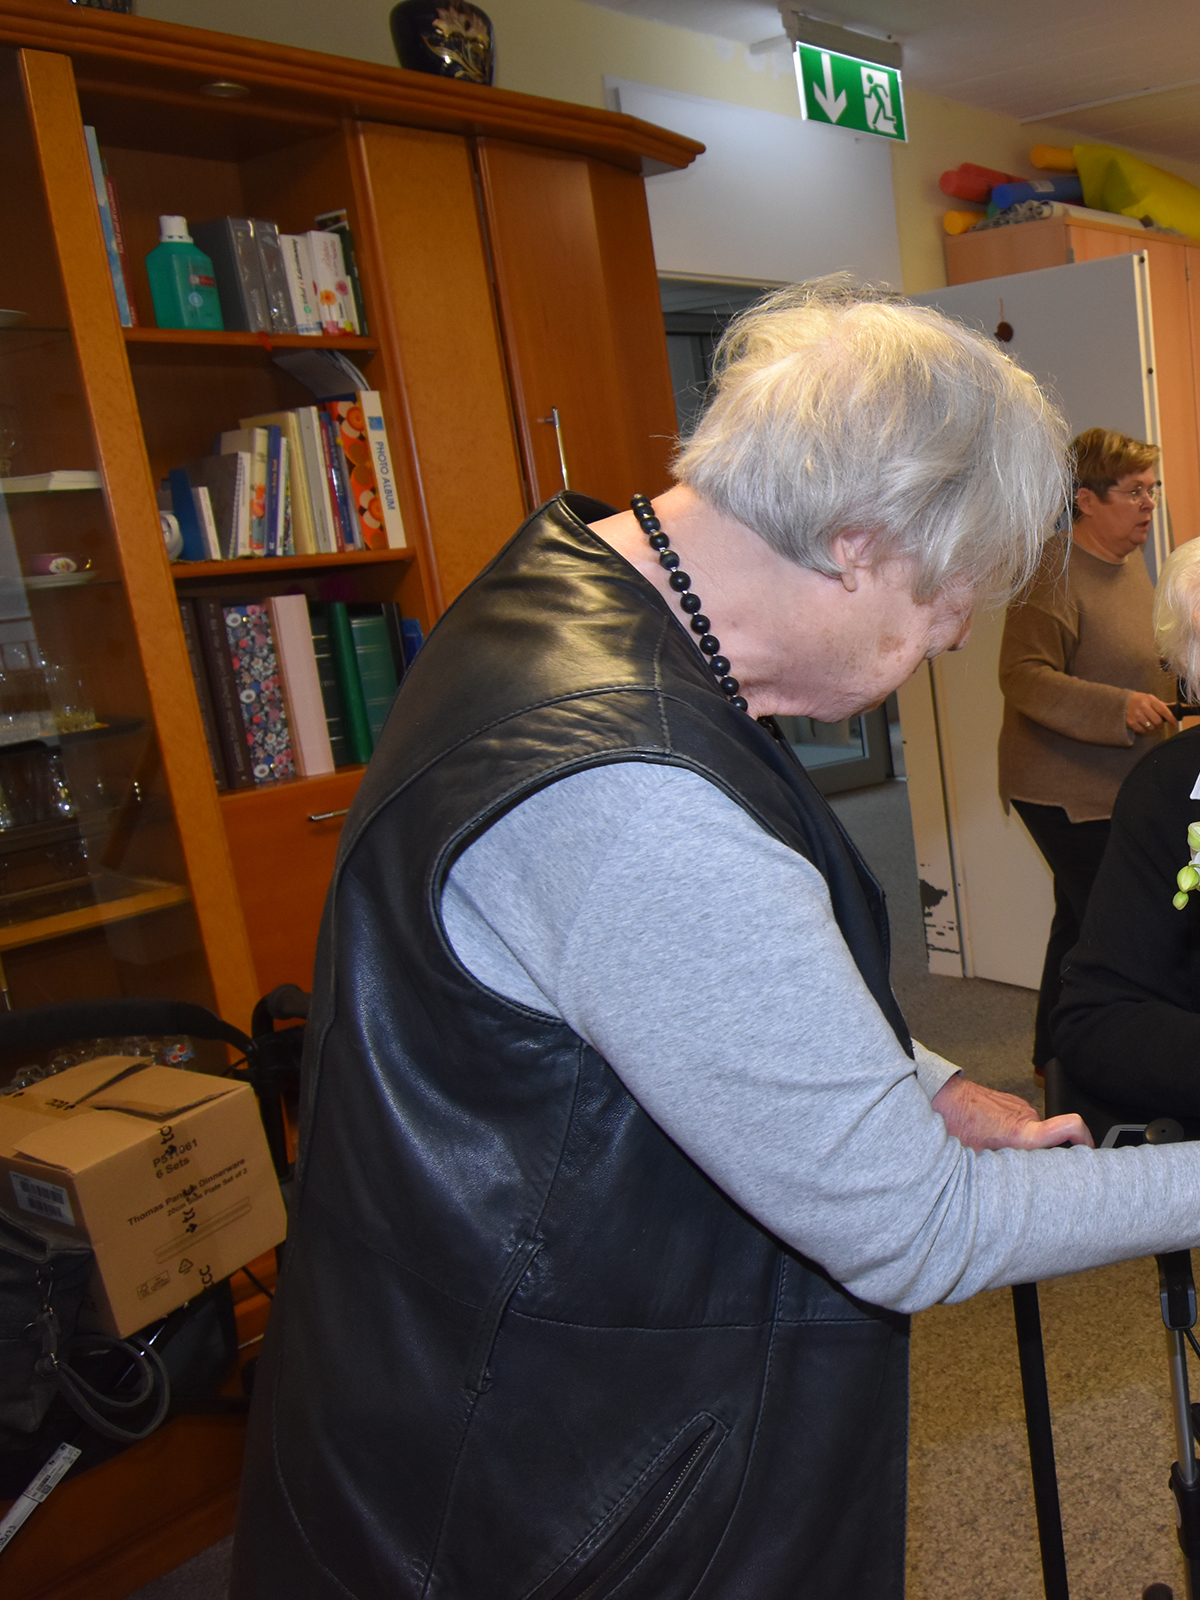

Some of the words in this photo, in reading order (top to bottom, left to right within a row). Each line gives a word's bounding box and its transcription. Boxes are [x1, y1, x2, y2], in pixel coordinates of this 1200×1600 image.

[375, 441, 389, 476] PHOTO
[381, 478, 396, 510] ALBUM
[155, 1169, 164, 1179] 6
[165, 1157, 190, 1174] Sets
[127, 1200, 164, 1226] Thomas
[199, 1158, 246, 1187] Dinnerware
[167, 1203, 187, 1217] 20cm
[203, 1183, 222, 1196] Plate
[222, 1175, 234, 1187] Set
[234, 1170, 243, 1180] of
